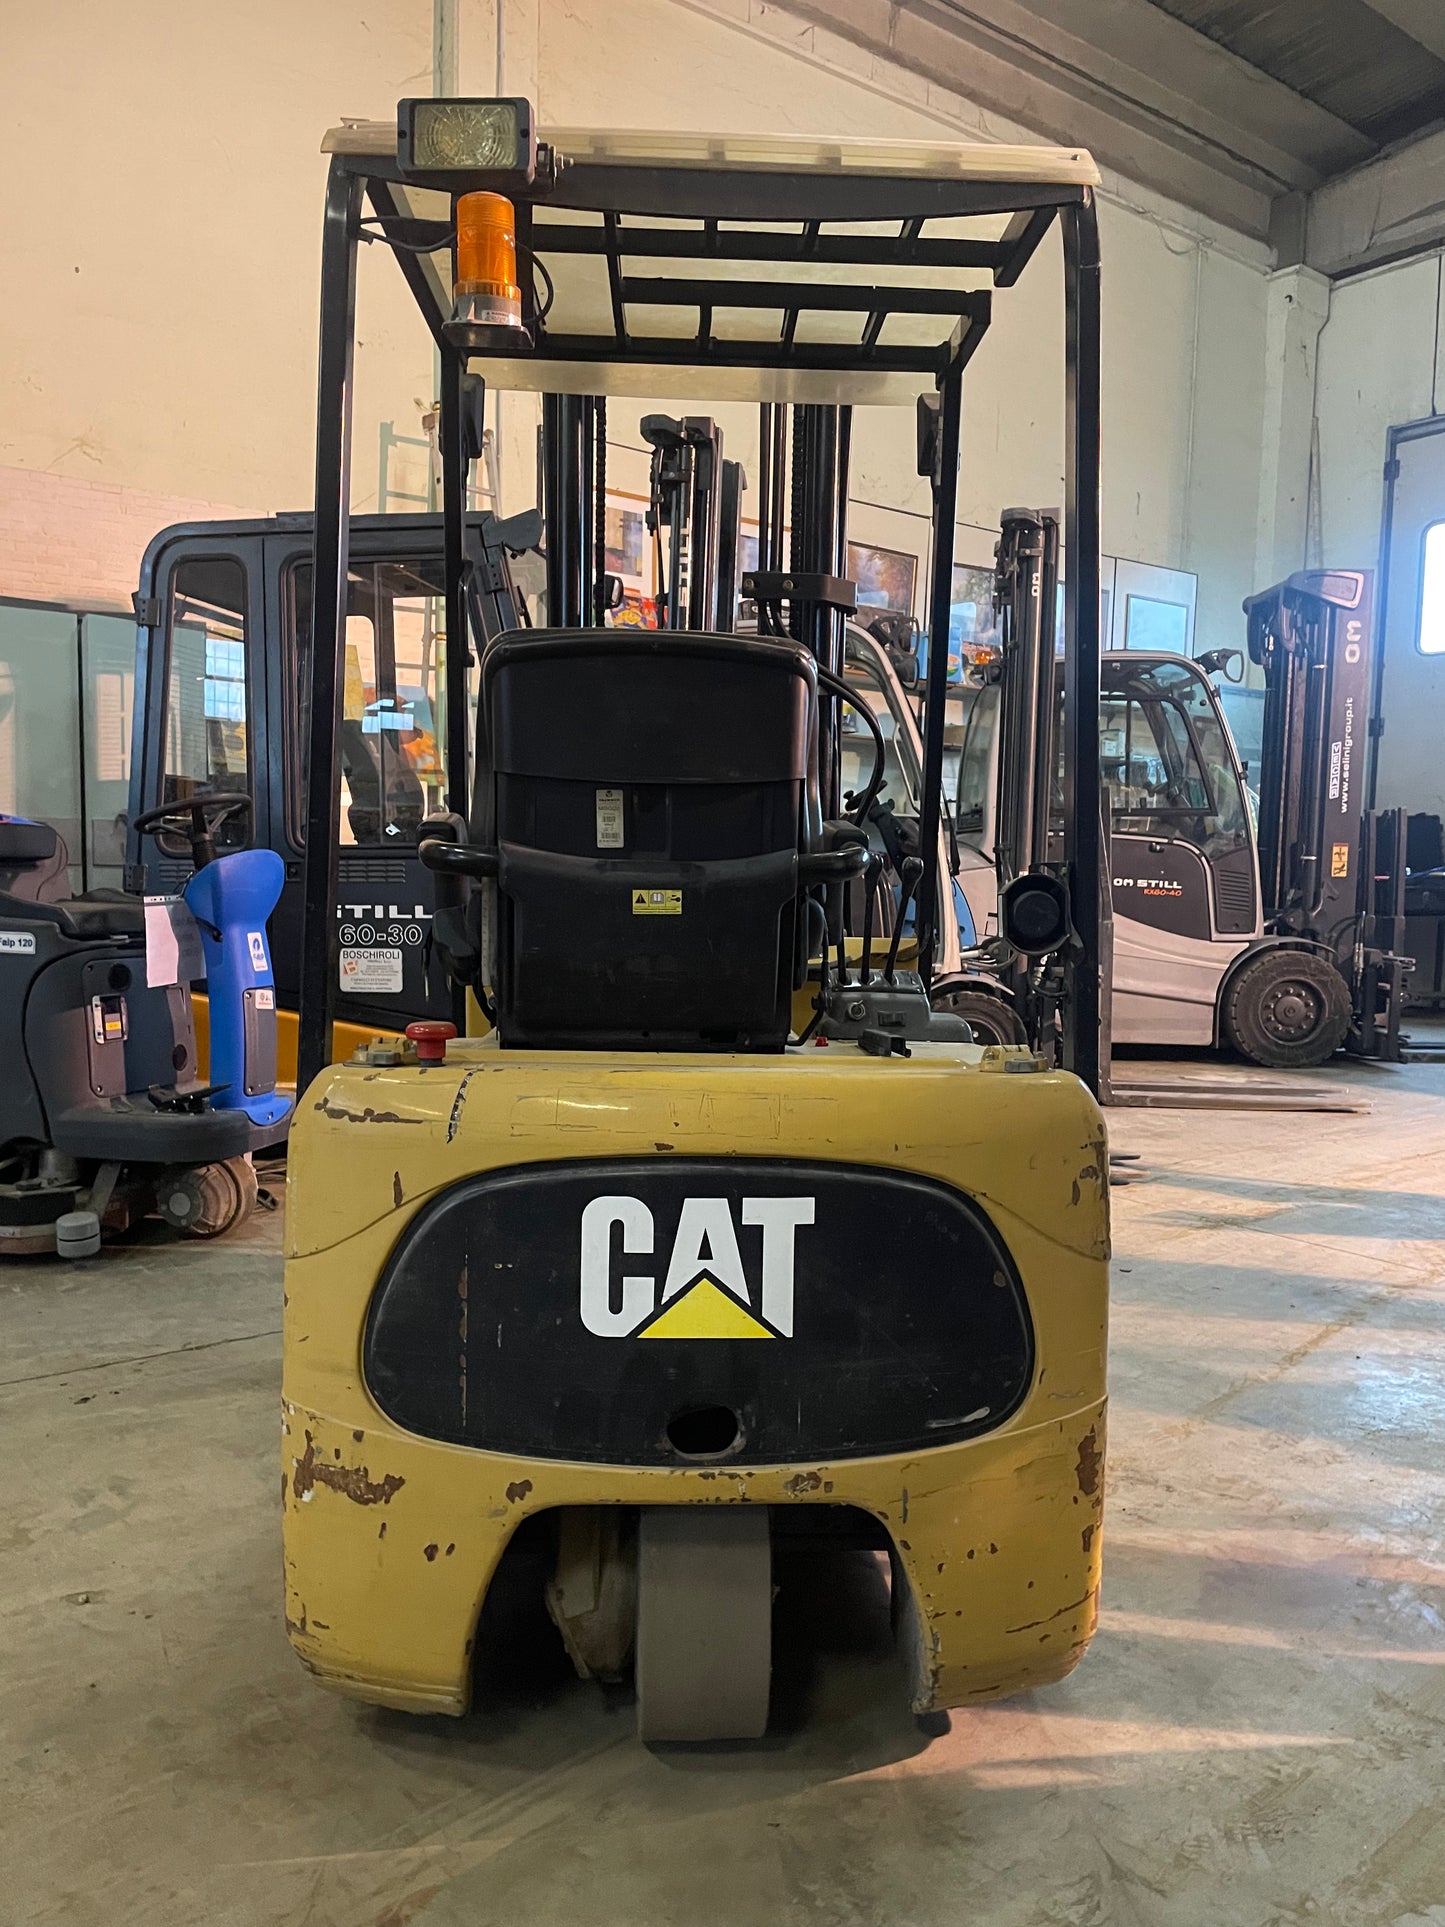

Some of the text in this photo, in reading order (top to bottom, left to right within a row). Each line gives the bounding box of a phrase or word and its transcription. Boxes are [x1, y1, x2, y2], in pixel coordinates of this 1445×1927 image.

[1345, 620, 1362, 664] OM
[1113, 878, 1182, 889] OM STILL
[18, 938, 33, 948] 120
[342, 950, 400, 960] BOSCHIROLI
[580, 1195, 816, 1338] CAT
